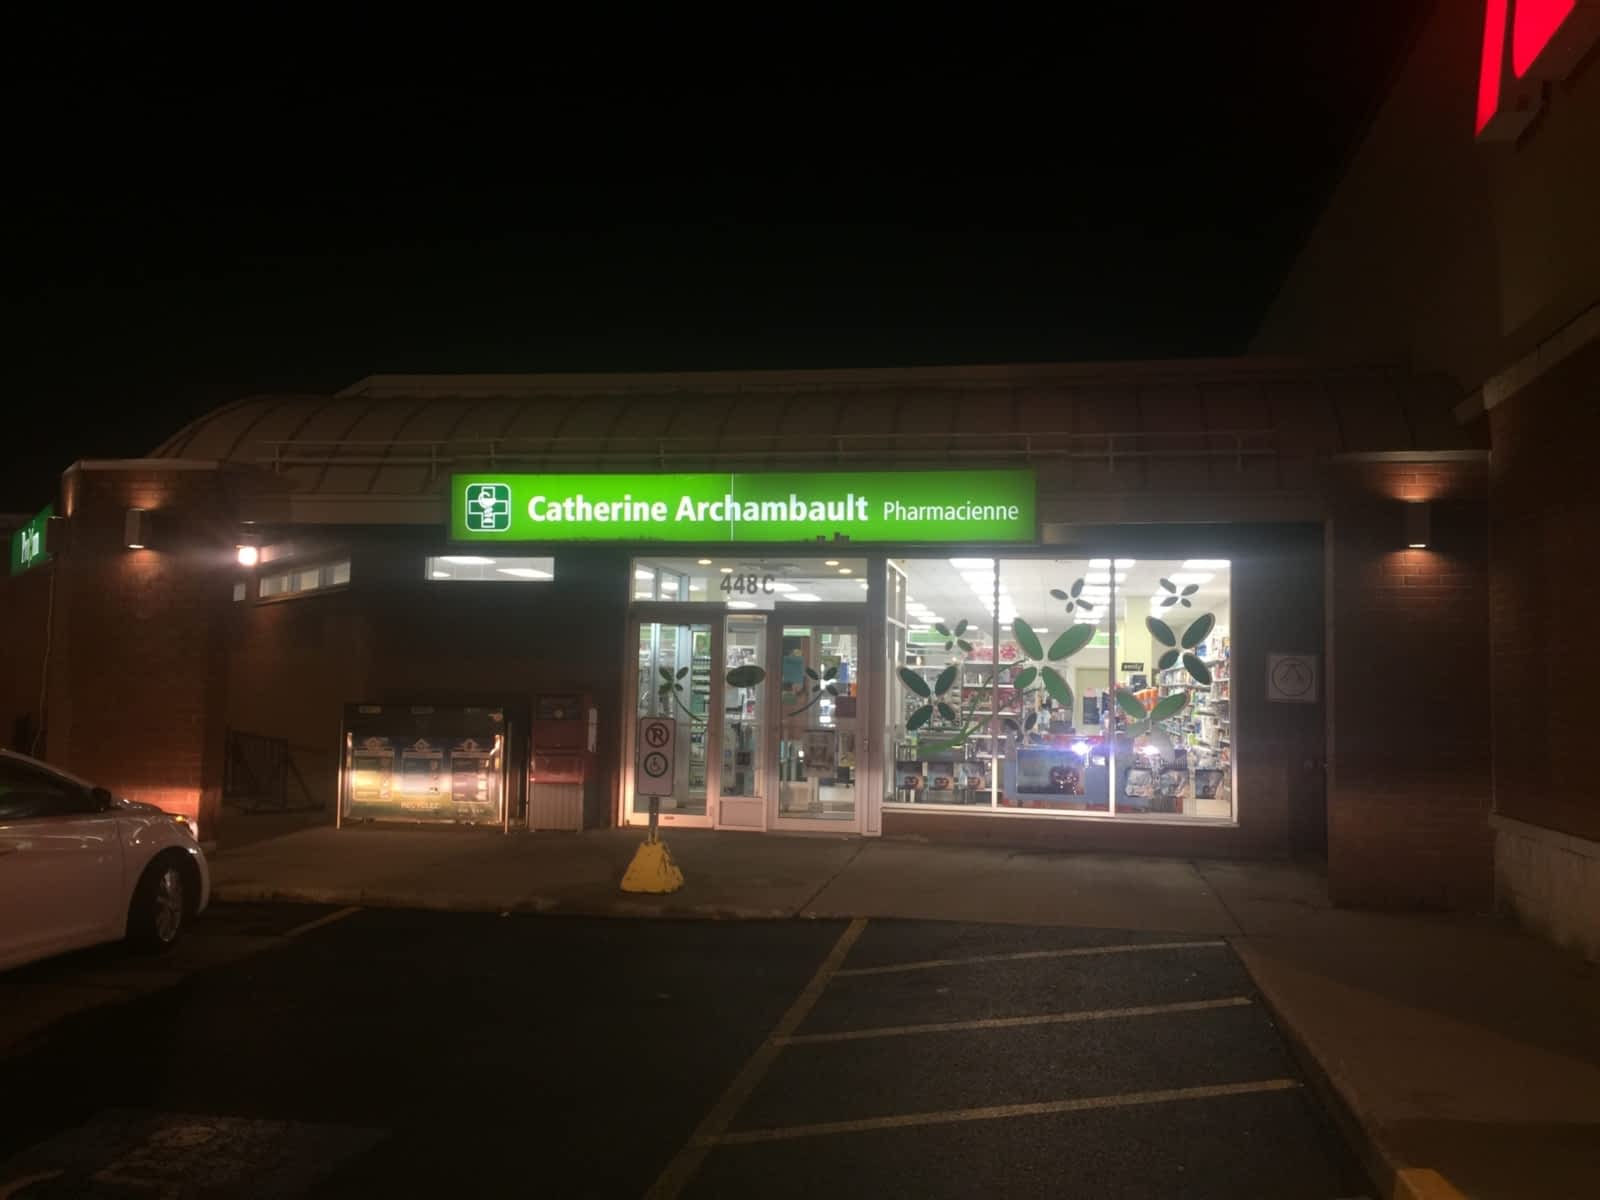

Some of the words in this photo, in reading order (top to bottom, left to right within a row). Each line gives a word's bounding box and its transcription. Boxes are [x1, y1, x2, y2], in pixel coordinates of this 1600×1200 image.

[527, 494, 668, 522] Catherine
[674, 493, 869, 523] Archambault
[882, 499, 1020, 522] Pharmacienne
[720, 574, 757, 594] 448
